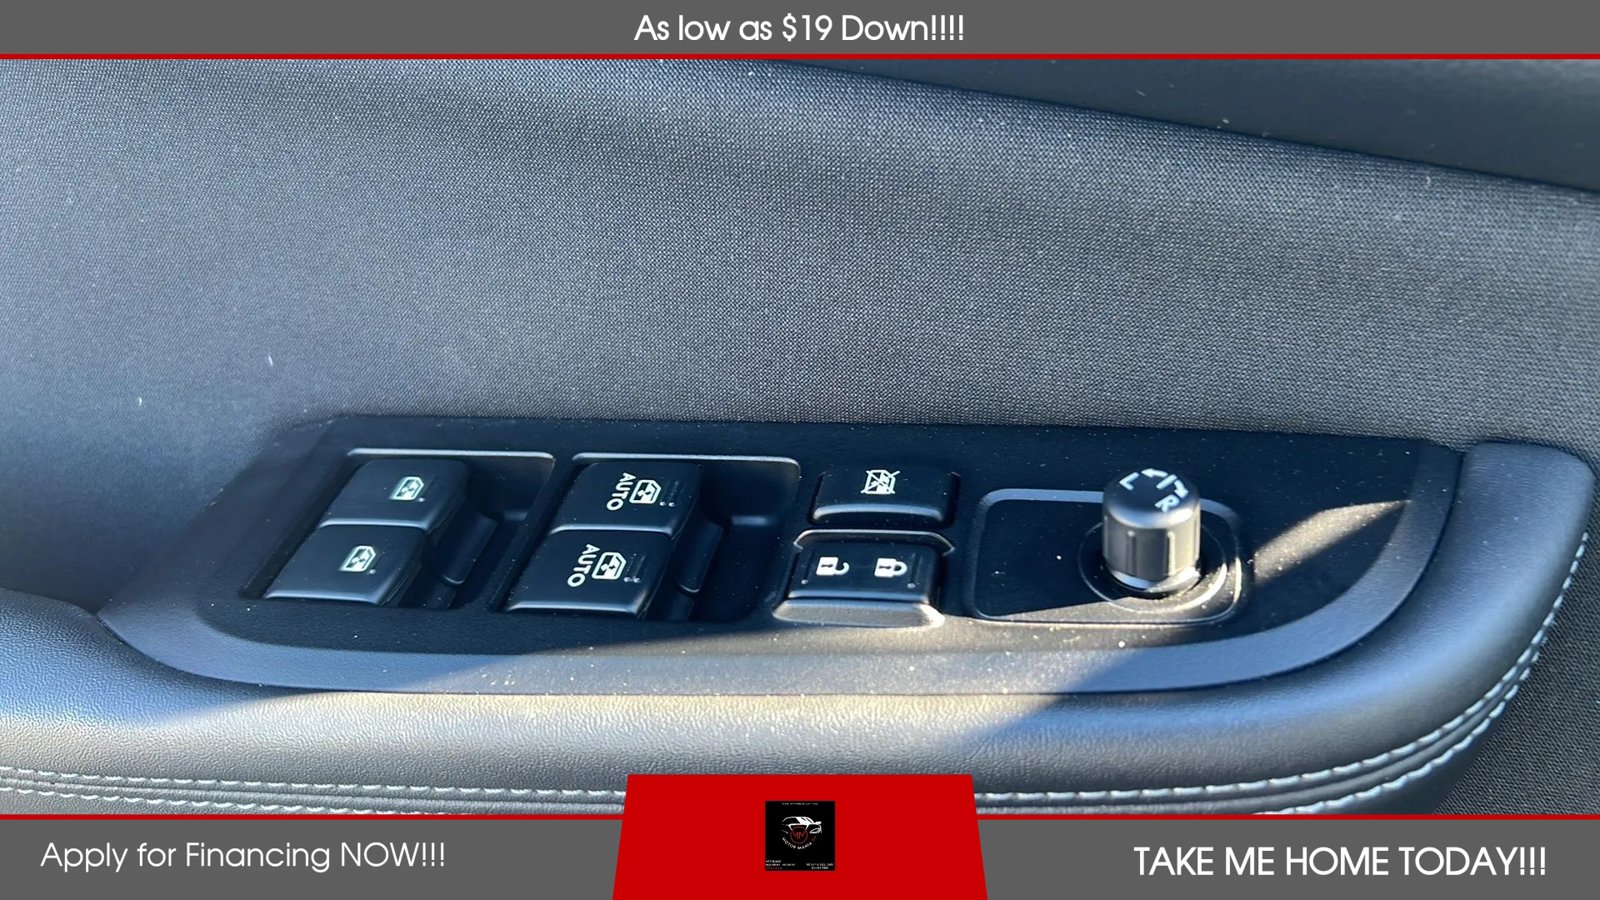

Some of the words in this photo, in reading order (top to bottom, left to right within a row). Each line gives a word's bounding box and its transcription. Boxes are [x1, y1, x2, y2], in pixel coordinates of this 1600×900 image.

[606, 472, 634, 511] AUTO
[1119, 471, 1140, 491] L
[1154, 494, 1180, 513] R
[567, 543, 600, 588] AUTO
